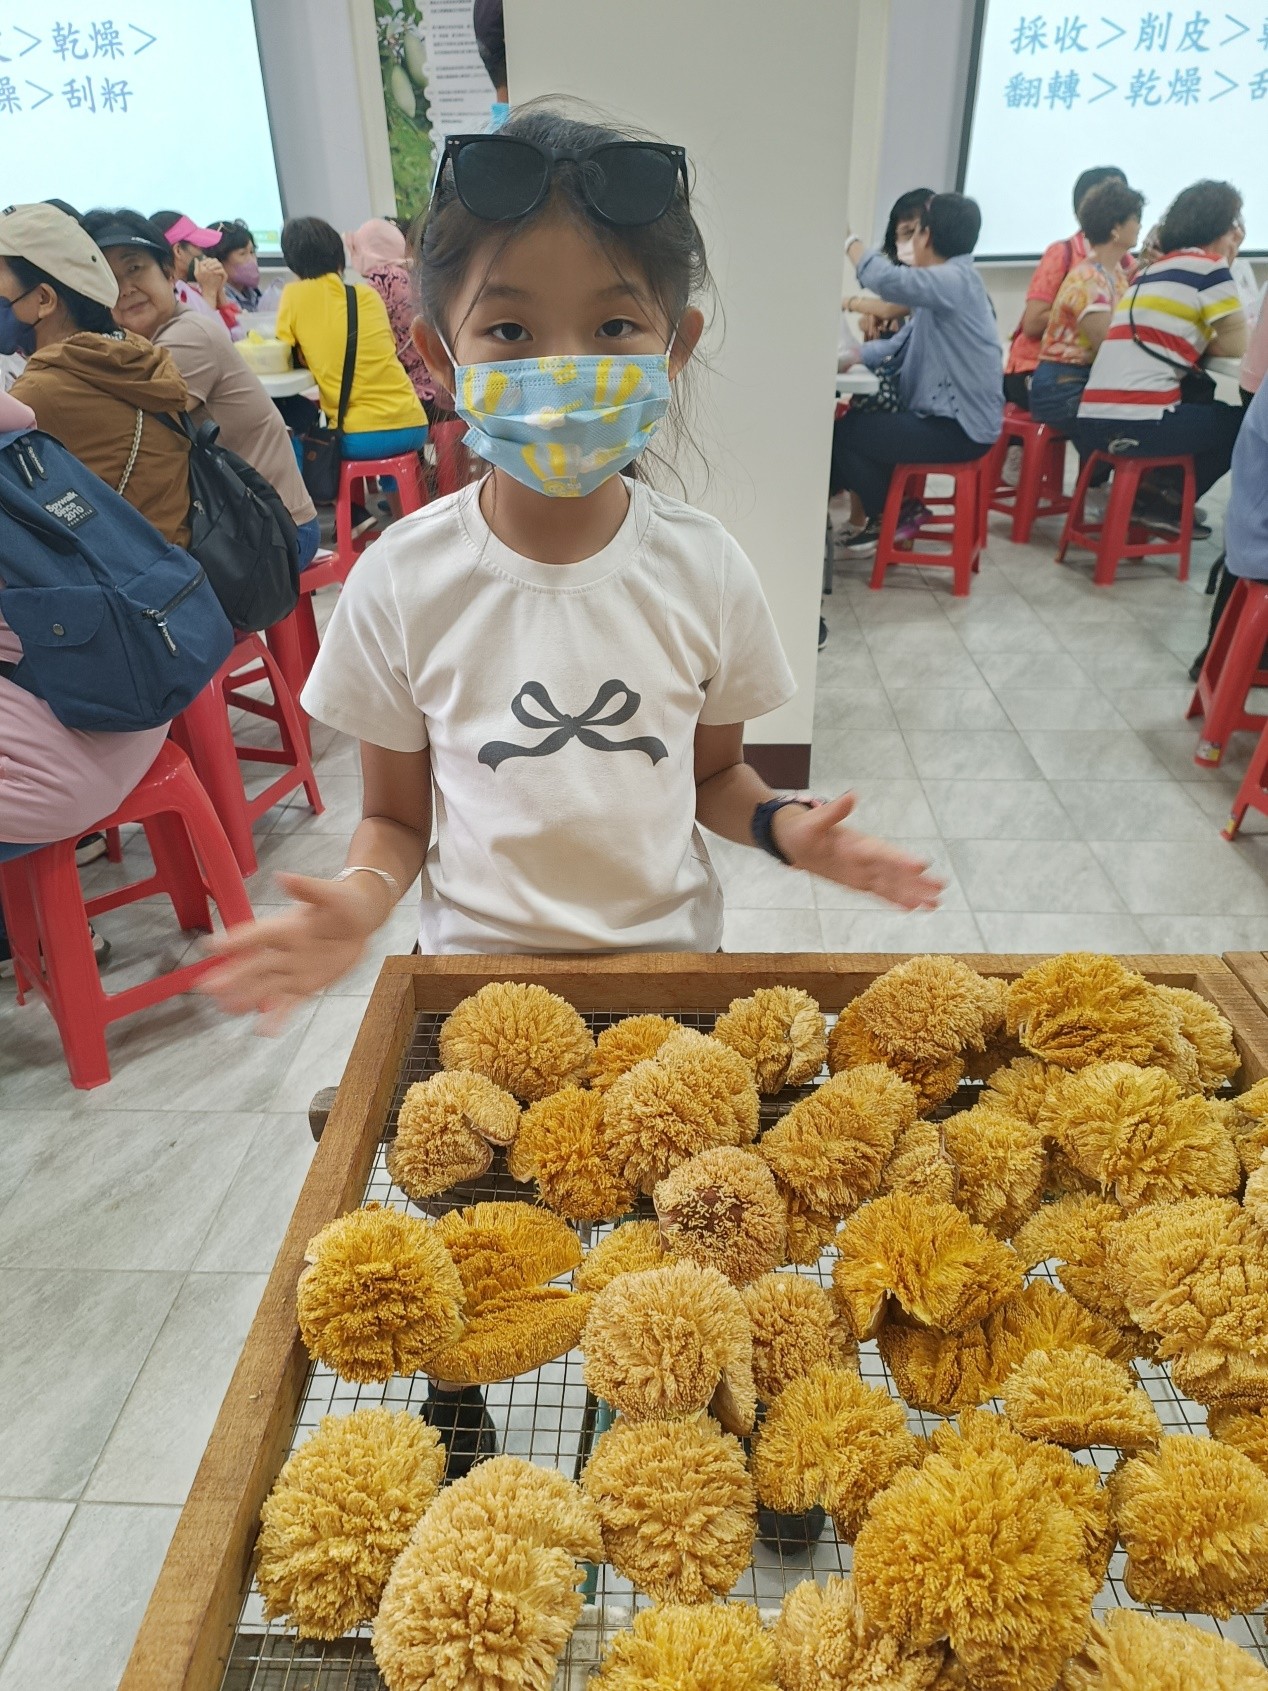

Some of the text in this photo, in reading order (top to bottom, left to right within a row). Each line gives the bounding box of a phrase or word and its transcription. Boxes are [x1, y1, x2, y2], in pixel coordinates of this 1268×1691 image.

[1010, 10, 1268, 55] 採收>削皮>
[45, 491, 78, 513] Spywalk
[54, 502, 77, 518] Since
[64, 505, 84, 522] 2010
